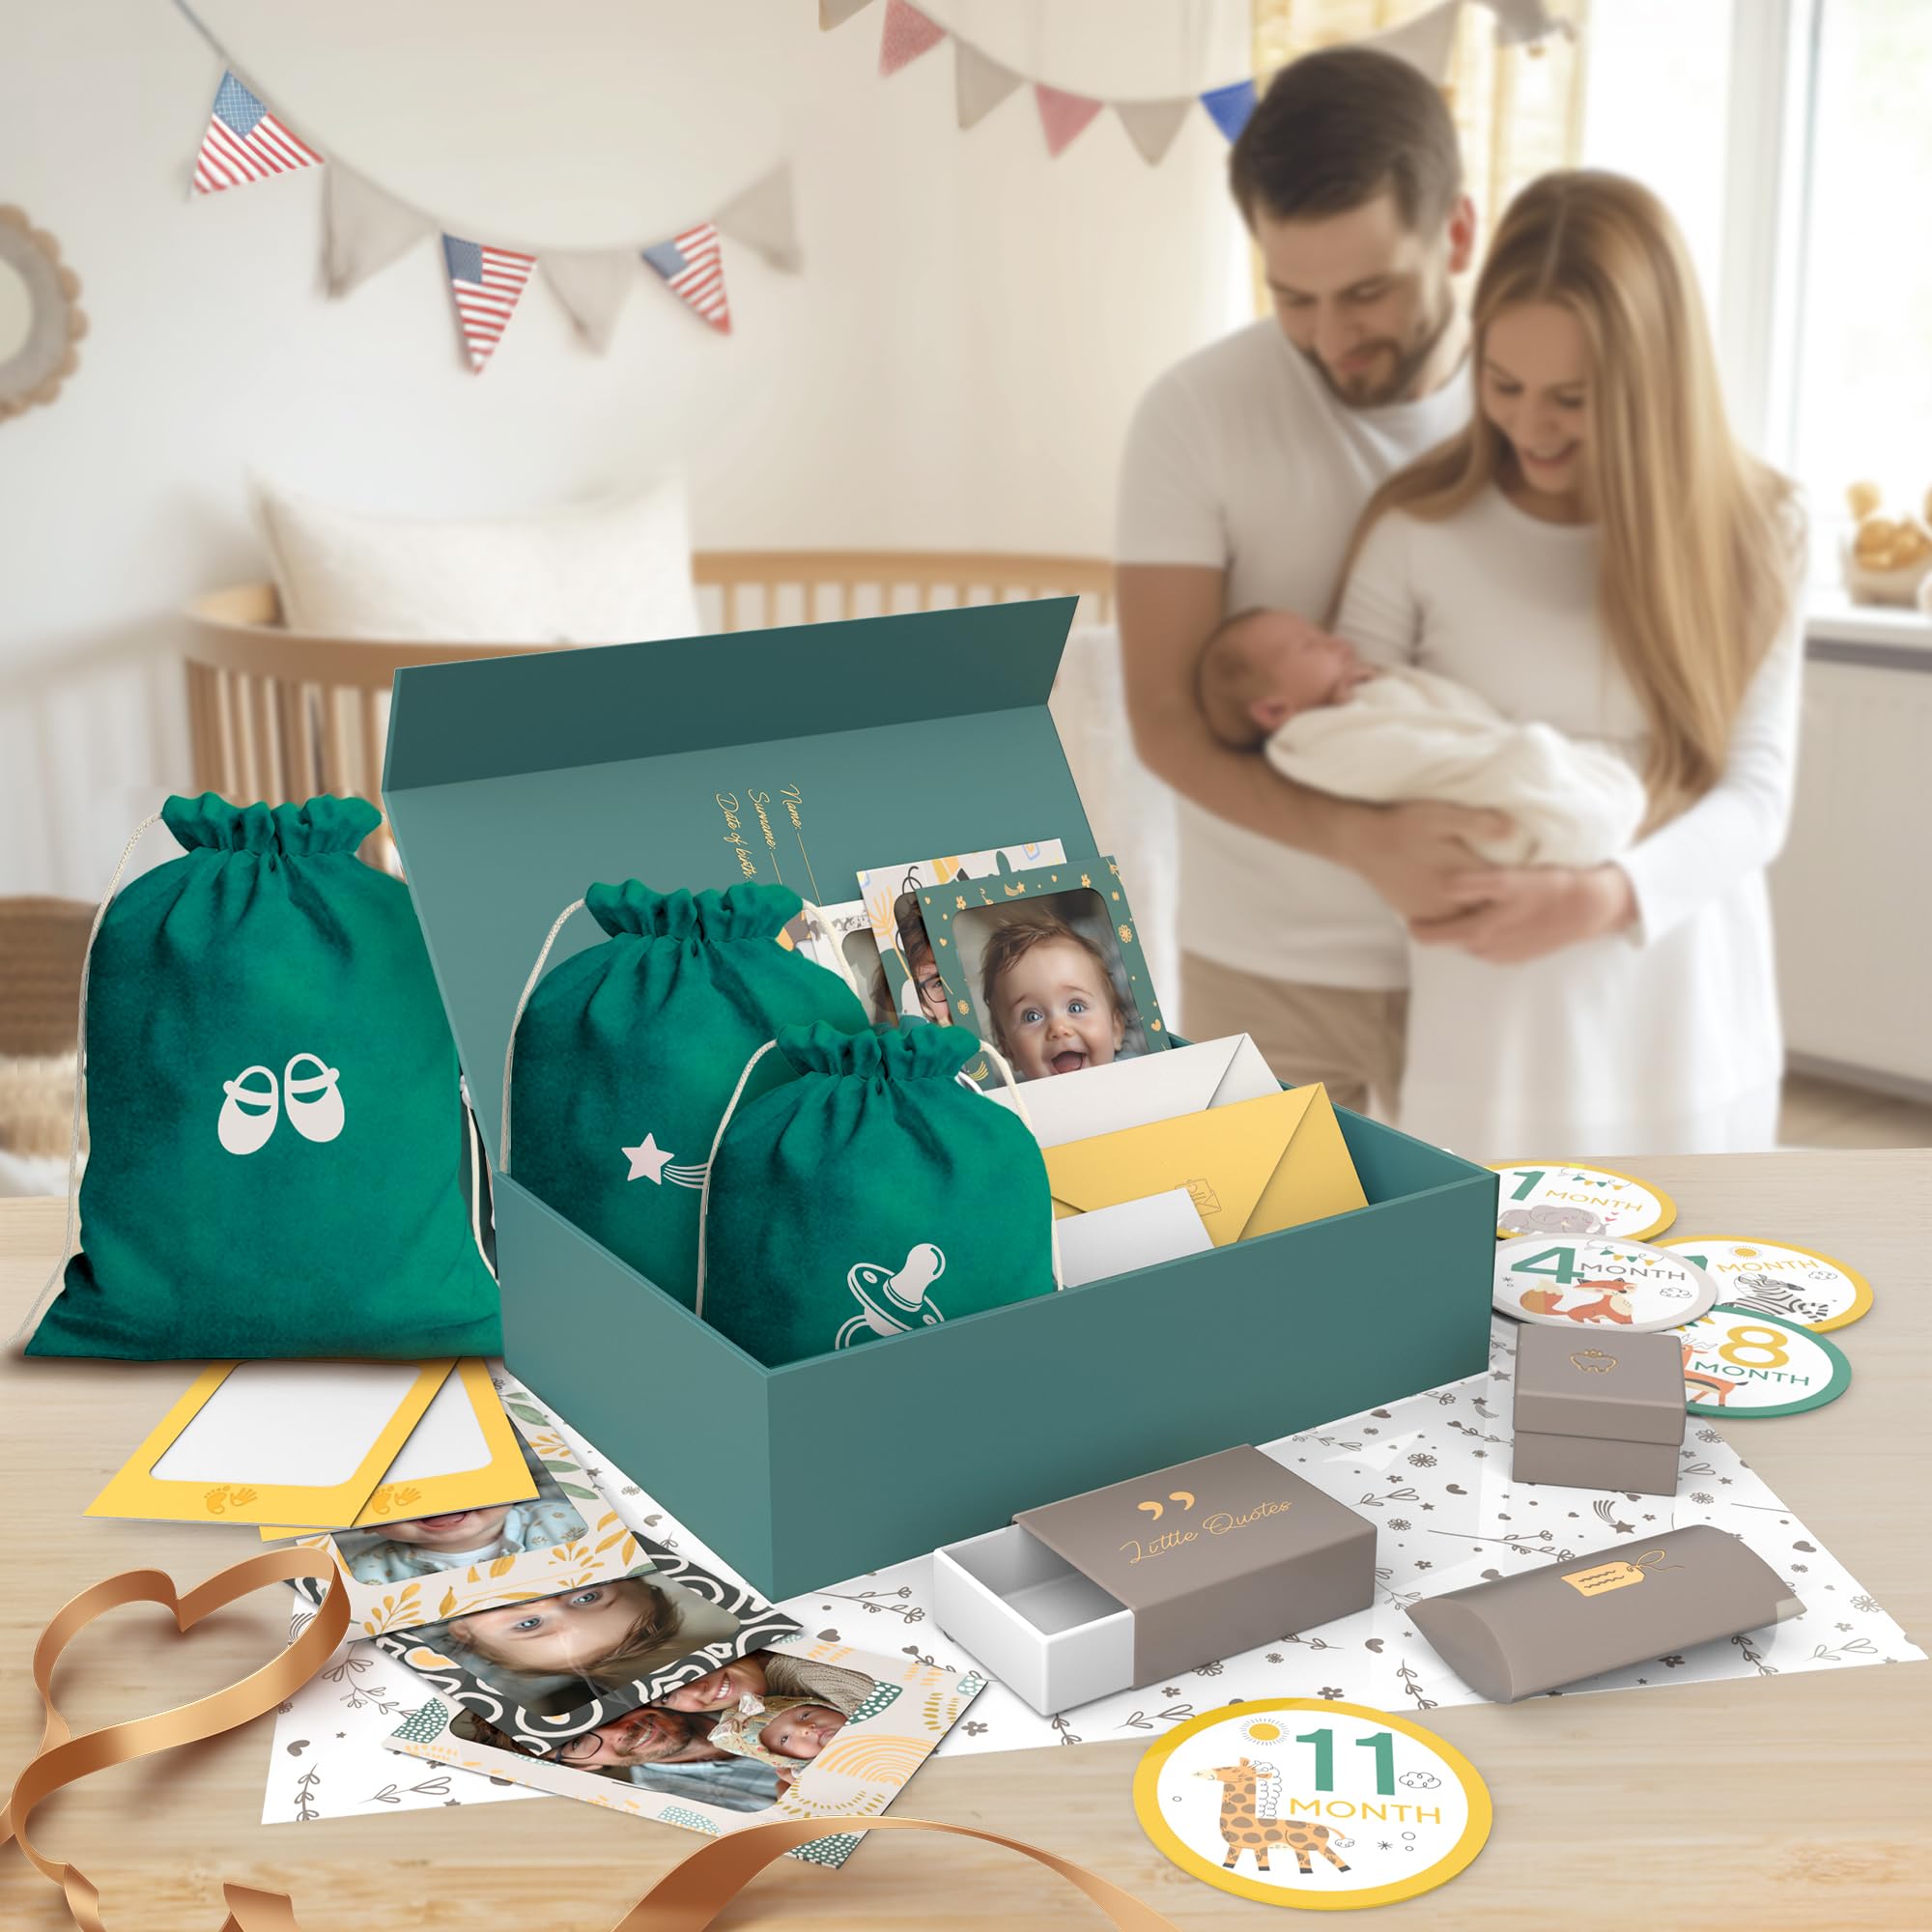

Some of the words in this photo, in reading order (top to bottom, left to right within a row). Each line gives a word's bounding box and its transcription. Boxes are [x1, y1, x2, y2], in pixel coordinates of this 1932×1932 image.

[715, 792, 742, 831] Date
[723, 832, 749, 846] of
[1510, 1171, 1546, 1201] 1
[1546, 1189, 1643, 1211] MONTH
[1511, 1246, 1585, 1284] 4
[1580, 1263, 1686, 1281] MONTH
[1716, 1259, 1819, 1273] MONTH
[1718, 1325, 1790, 1370] 8
[1694, 1361, 1810, 1386] MONTH
[1120, 1529, 1199, 1565] Little
[1202, 1500, 1293, 1535] Quotes
[1295, 1728, 1396, 1796] 11
[1290, 1798, 1441, 1825] MONTH
